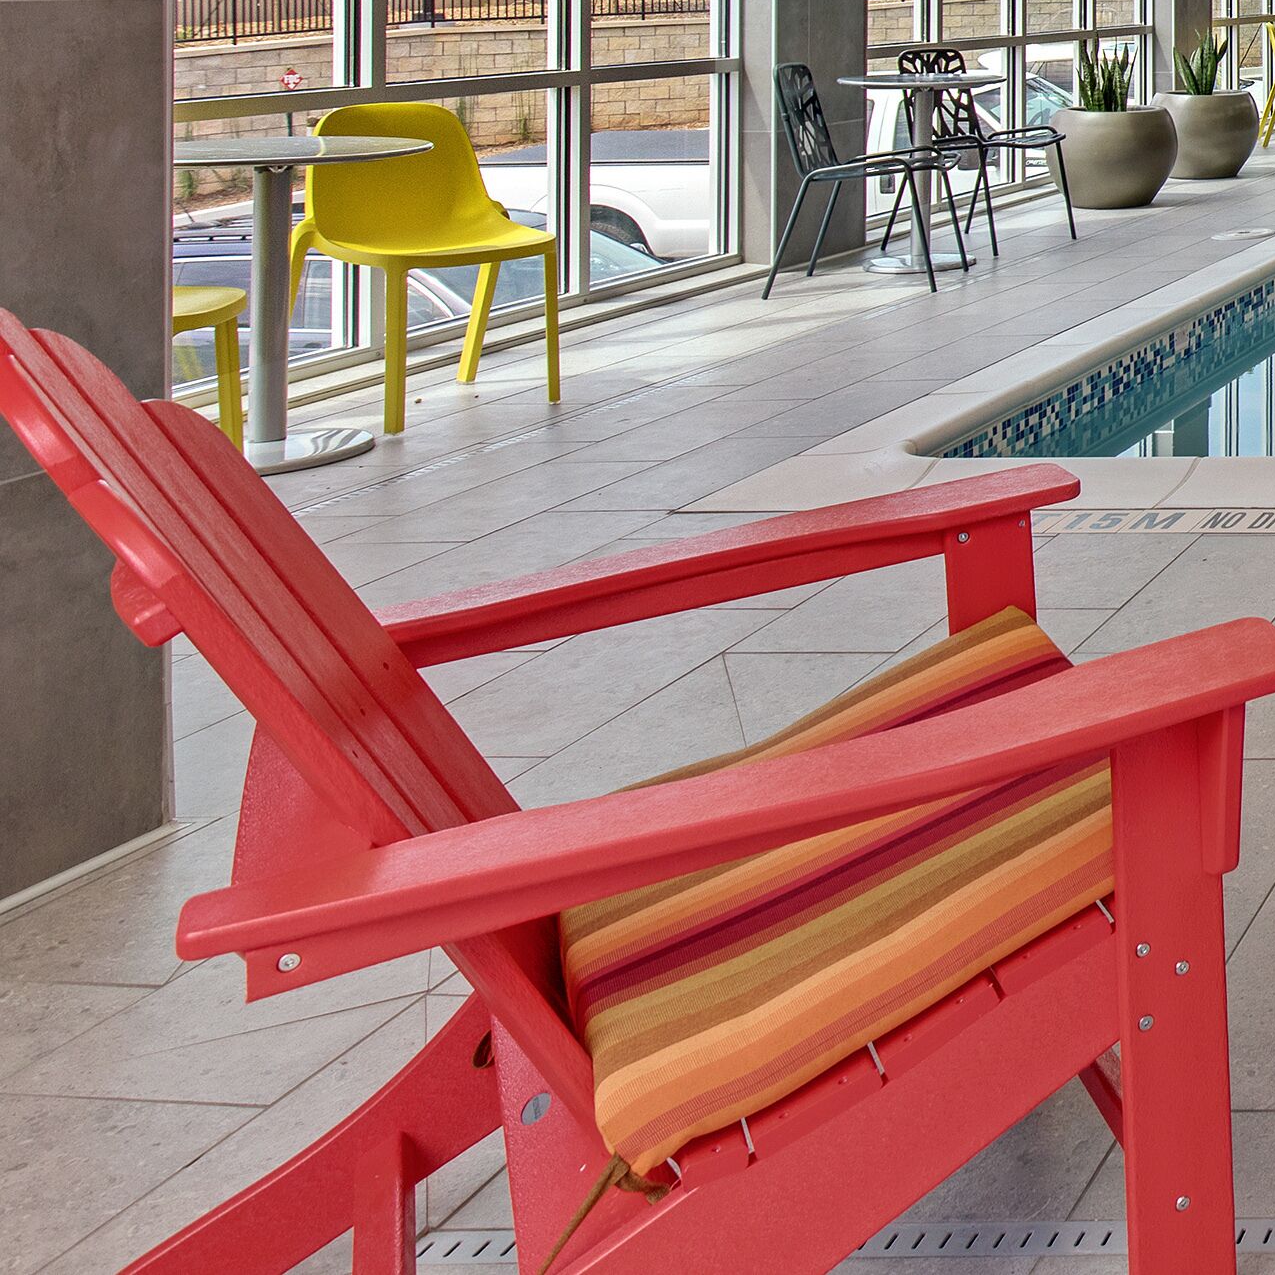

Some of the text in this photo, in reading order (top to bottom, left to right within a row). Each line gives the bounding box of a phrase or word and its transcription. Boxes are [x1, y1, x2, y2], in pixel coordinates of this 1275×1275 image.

[284, 74, 300, 84] FDC
[1128, 512, 1186, 530] M
[1202, 512, 1246, 530] NO
